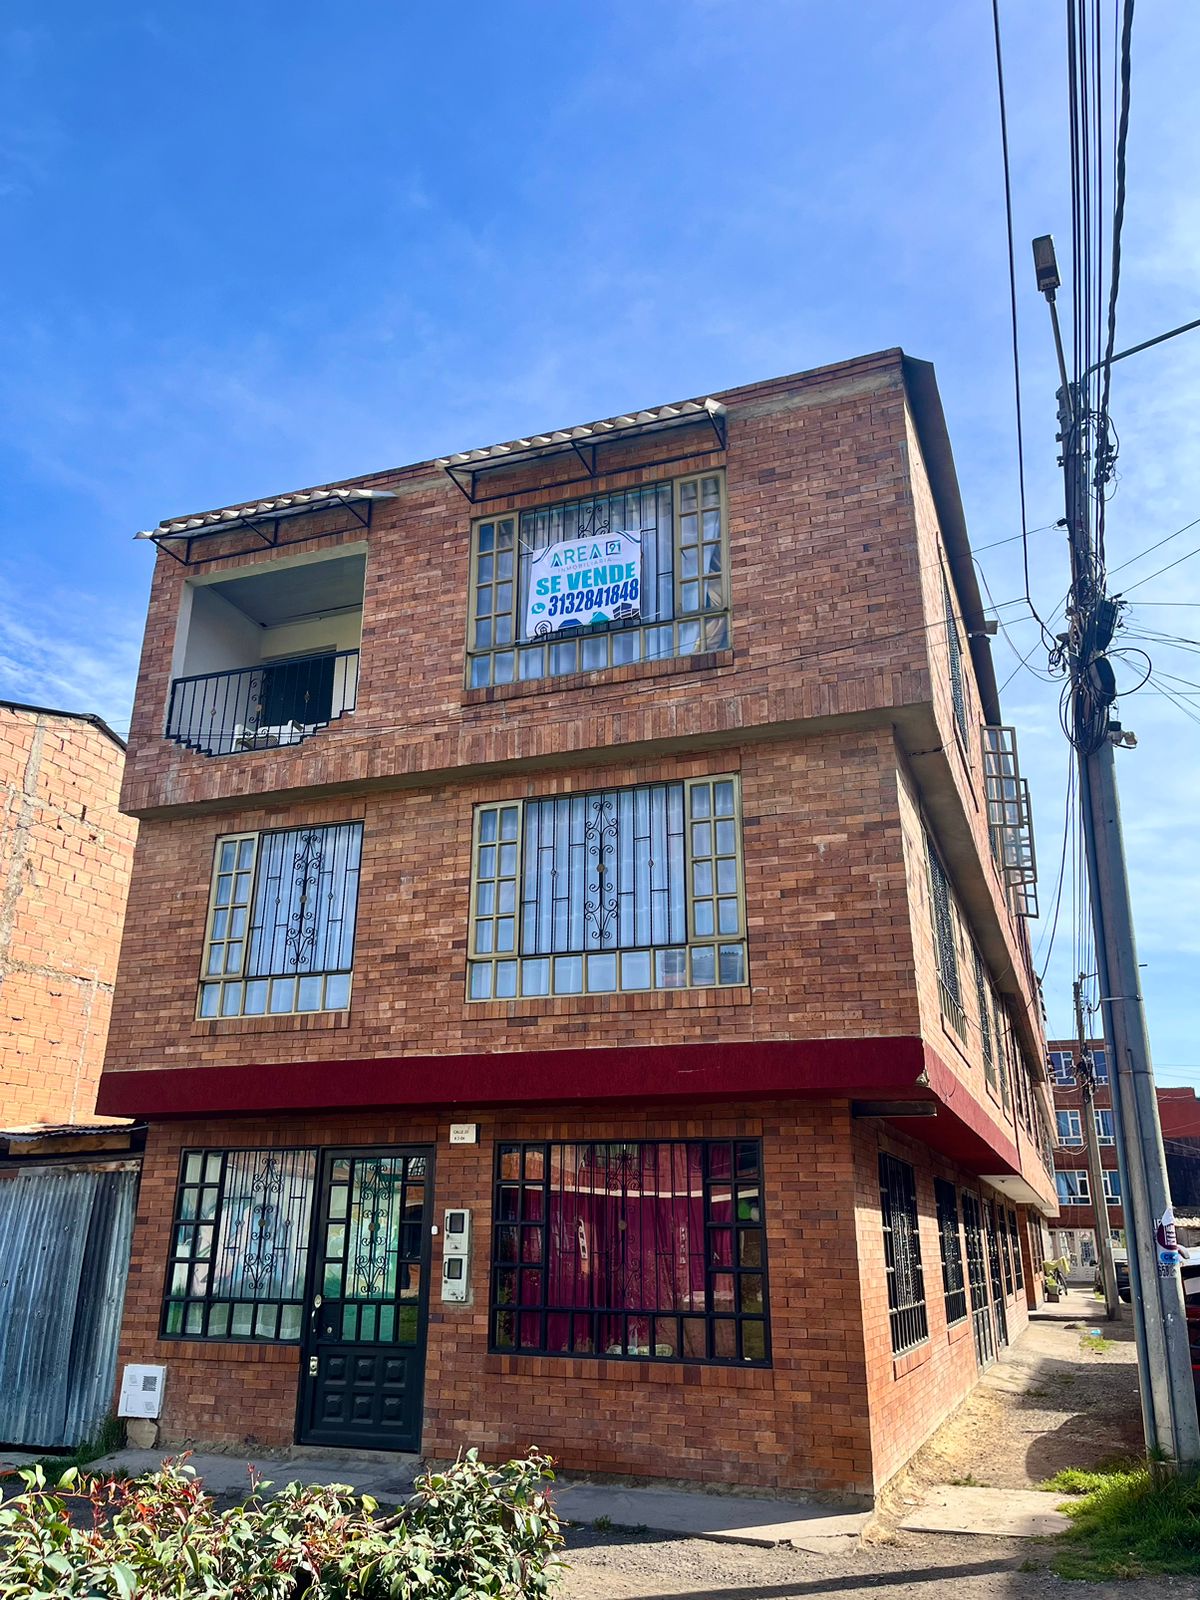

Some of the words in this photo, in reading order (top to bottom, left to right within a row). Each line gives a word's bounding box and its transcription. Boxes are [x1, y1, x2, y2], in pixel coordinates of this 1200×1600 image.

[550, 544, 602, 568] AREA
[558, 557, 612, 573] INMOBILIARIA
[536, 575, 561, 596] SE
[567, 562, 636, 591] VENDE
[548, 578, 639, 617] 3132841848
